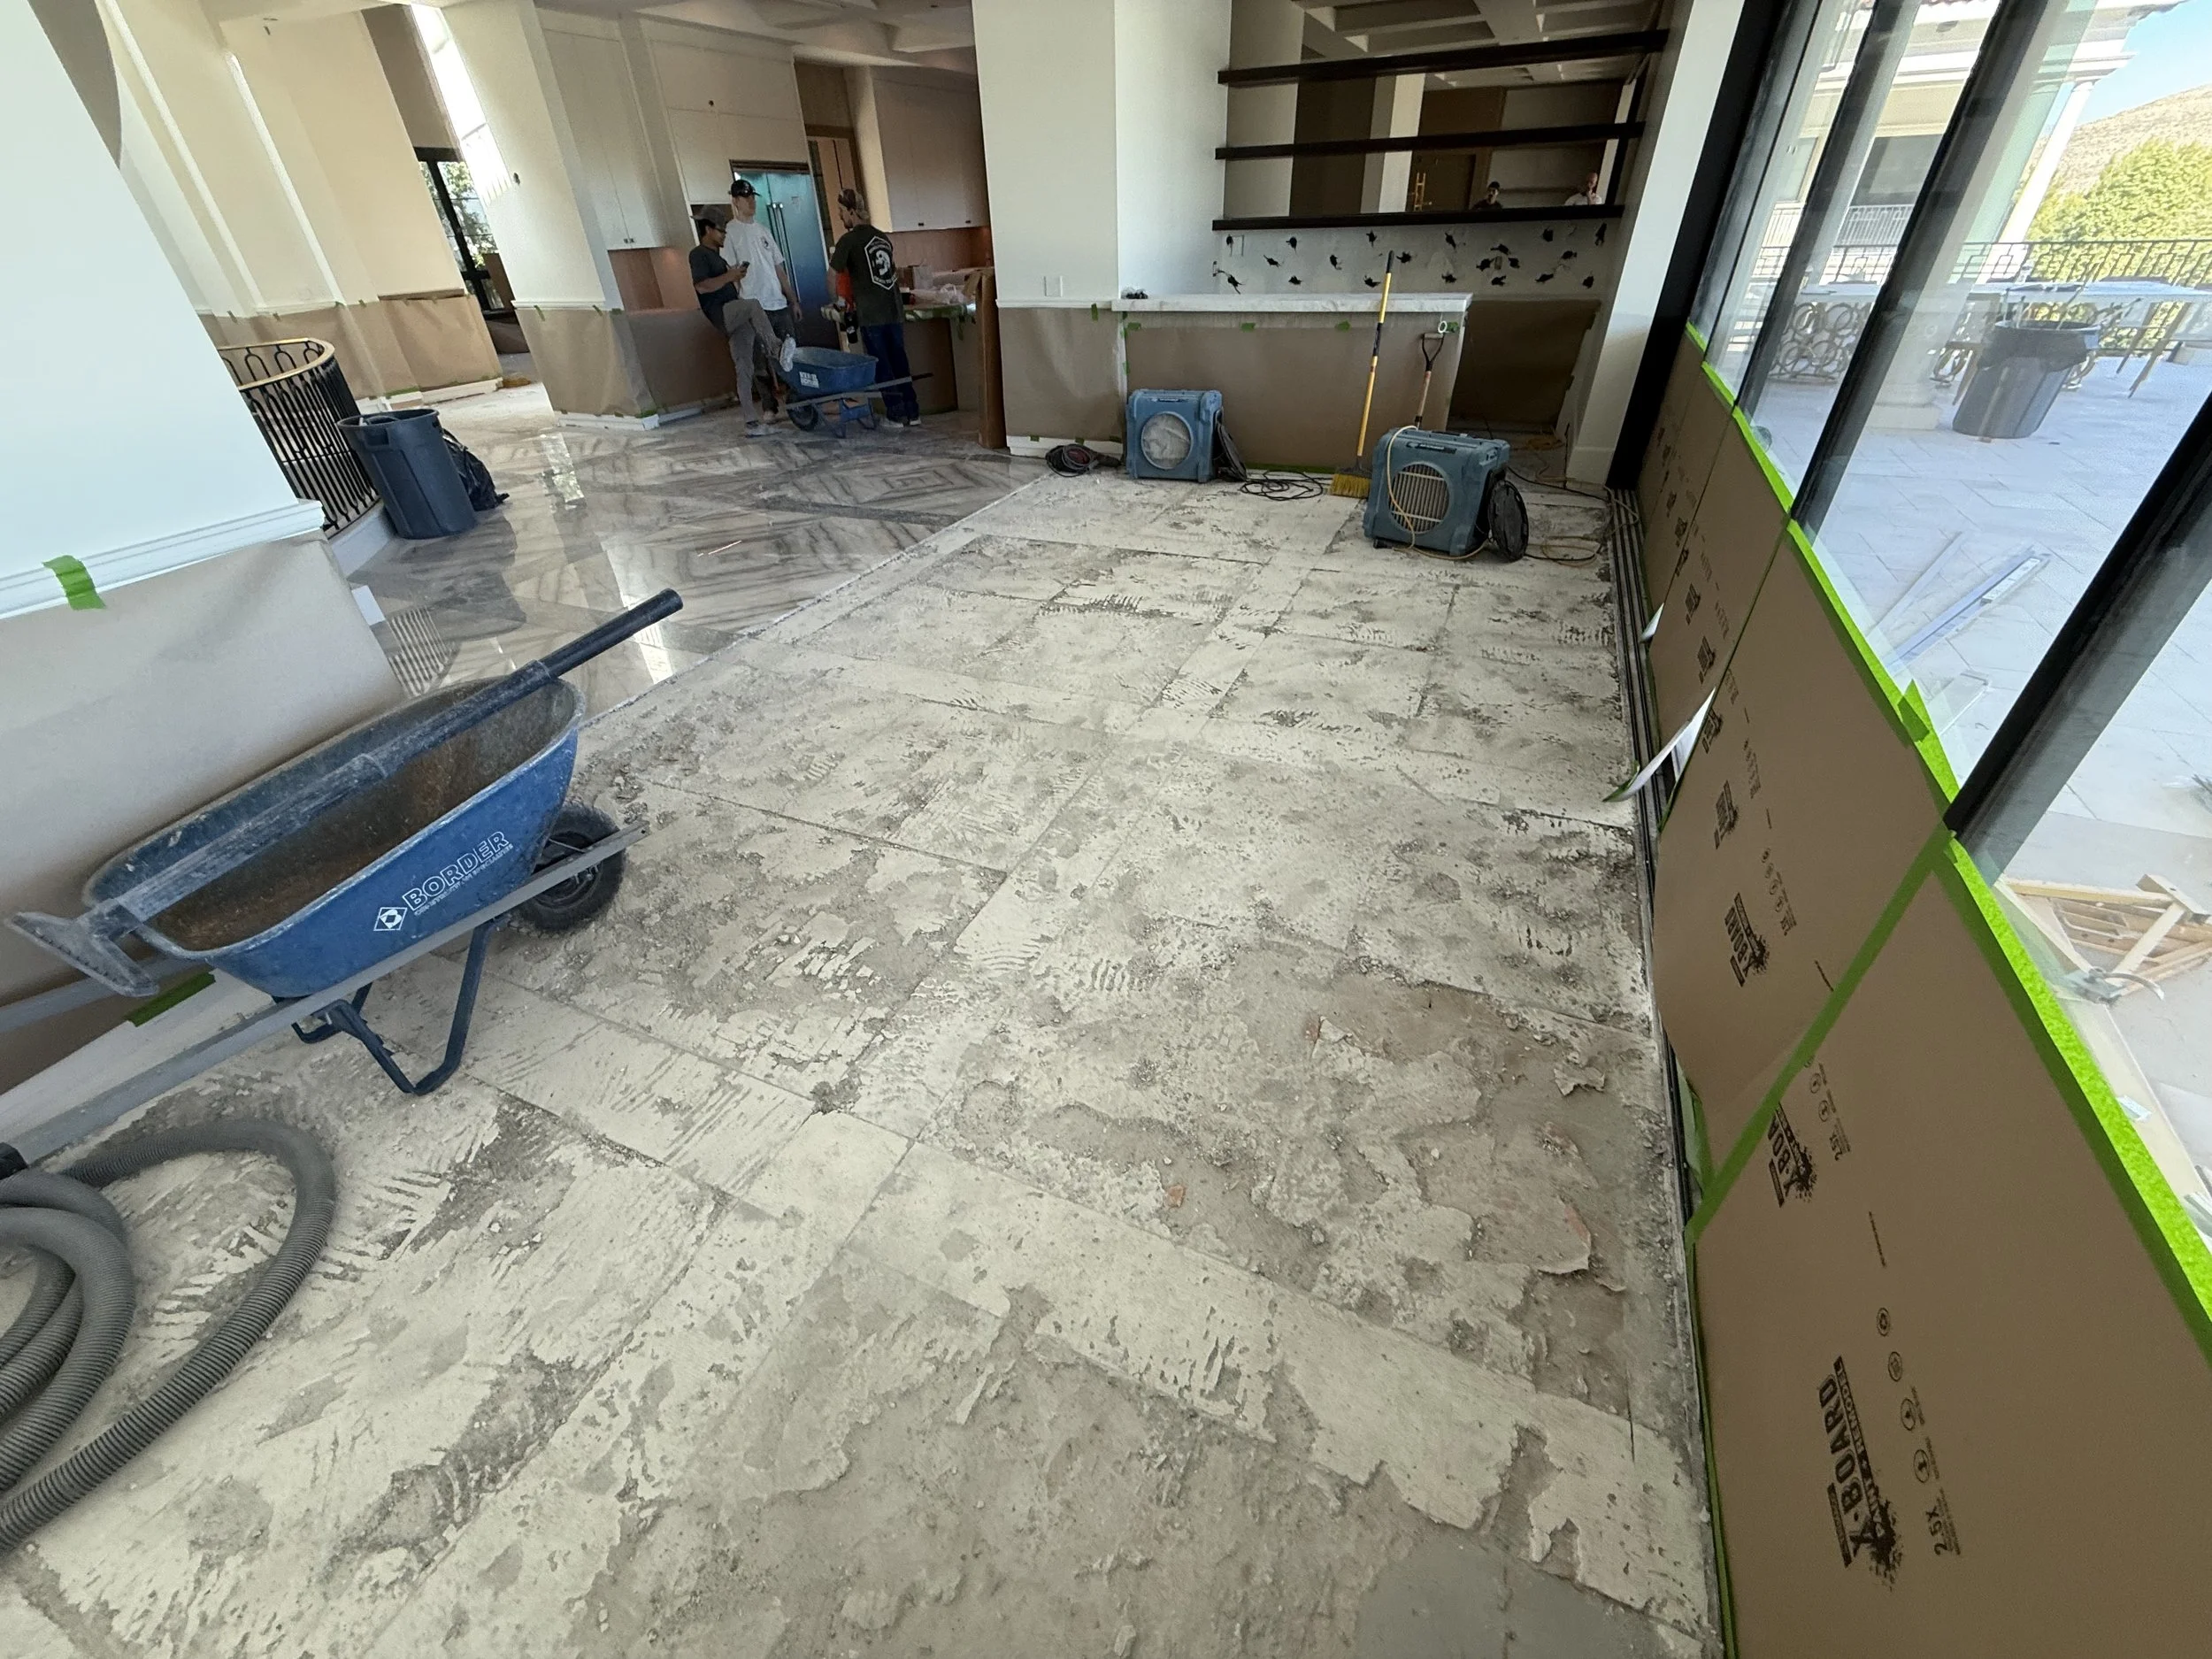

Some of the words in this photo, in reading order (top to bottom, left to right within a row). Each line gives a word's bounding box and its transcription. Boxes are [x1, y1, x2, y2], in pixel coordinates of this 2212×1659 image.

[402, 831, 510, 911] BORDER
[1835, 1363, 1864, 1455] REMODEL
[1863, 1478, 1886, 1538] PAINT
[1925, 1505, 1947, 1555] 2.5X
